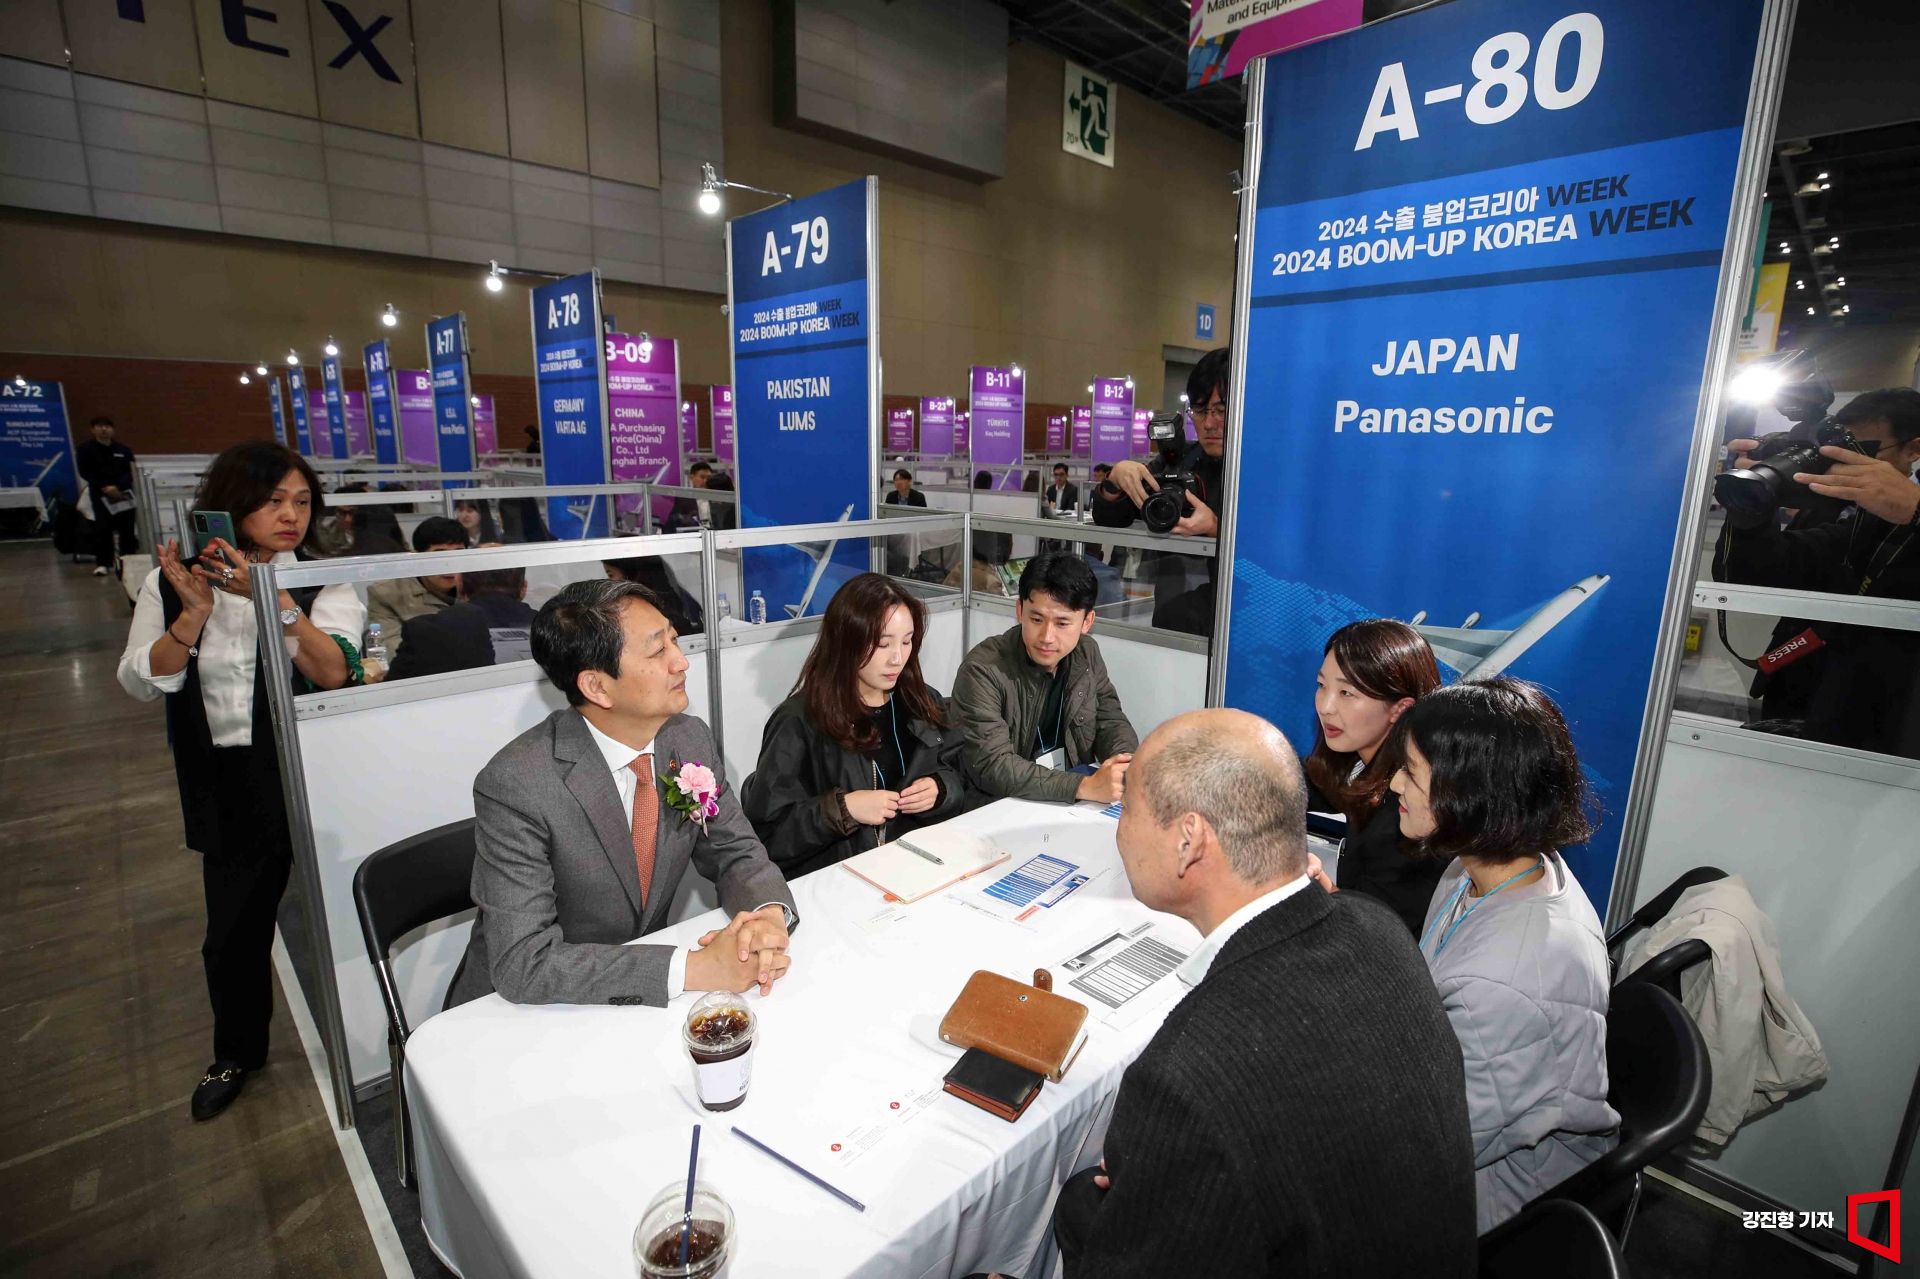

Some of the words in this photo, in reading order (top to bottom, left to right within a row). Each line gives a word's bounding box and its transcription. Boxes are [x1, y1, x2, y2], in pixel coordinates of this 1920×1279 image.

[1227, 6, 1250, 24] and
[1252, 0, 1297, 15] Equip
[117, 0, 402, 84] EX
[1353, 12, 1604, 152] A-80
[1318, 215, 1368, 241] 2024
[1374, 206, 1415, 234] 수출
[1422, 186, 1539, 230] 붐업코리아
[1547, 173, 1630, 208] WEEK
[761, 216, 830, 277] A-79
[1271, 247, 1332, 276] 2024
[1337, 229, 1465, 269] BOOM-UP
[1473, 214, 1578, 252] KOREA
[1588, 197, 1696, 237] WEEK
[548, 293, 580, 329] A-78
[754, 311, 770, 324] 2024
[771, 307, 784, 322] 수출
[819, 297, 842, 313] WEEK
[740, 327, 760, 342] 2024
[761, 321, 799, 340] BOOM-UP
[800, 316, 831, 334] KOREA
[832, 311, 860, 329] WEEK
[436, 329, 454, 355] A-77
[1371, 333, 1520, 377] JAPAN
[2, 384, 43, 397] A-72
[416, 376, 431, 390] B-
[767, 376, 830, 400] PAKISTAN
[986, 372, 1010, 388] B-11
[1104, 384, 1124, 398] B-12
[554, 398, 584, 413] GERMANY
[614, 408, 645, 418] CHINA
[929, 402, 947, 411] B-23
[1334, 396, 1554, 435] Panasonic
[555, 422, 577, 434] VARTA
[577, 421, 587, 433] AG
[610, 424, 617, 432] A
[619, 424, 666, 435] Purchasing
[779, 411, 816, 431] LUMS
[611, 434, 663, 443] rvice(China)
[616, 445, 633, 455] Co.,
[635, 445, 649, 454] Ltd
[612, 457, 637, 467] nghai
[638, 457, 668, 465] Branch
[1767, 636, 1808, 663] PRESS
